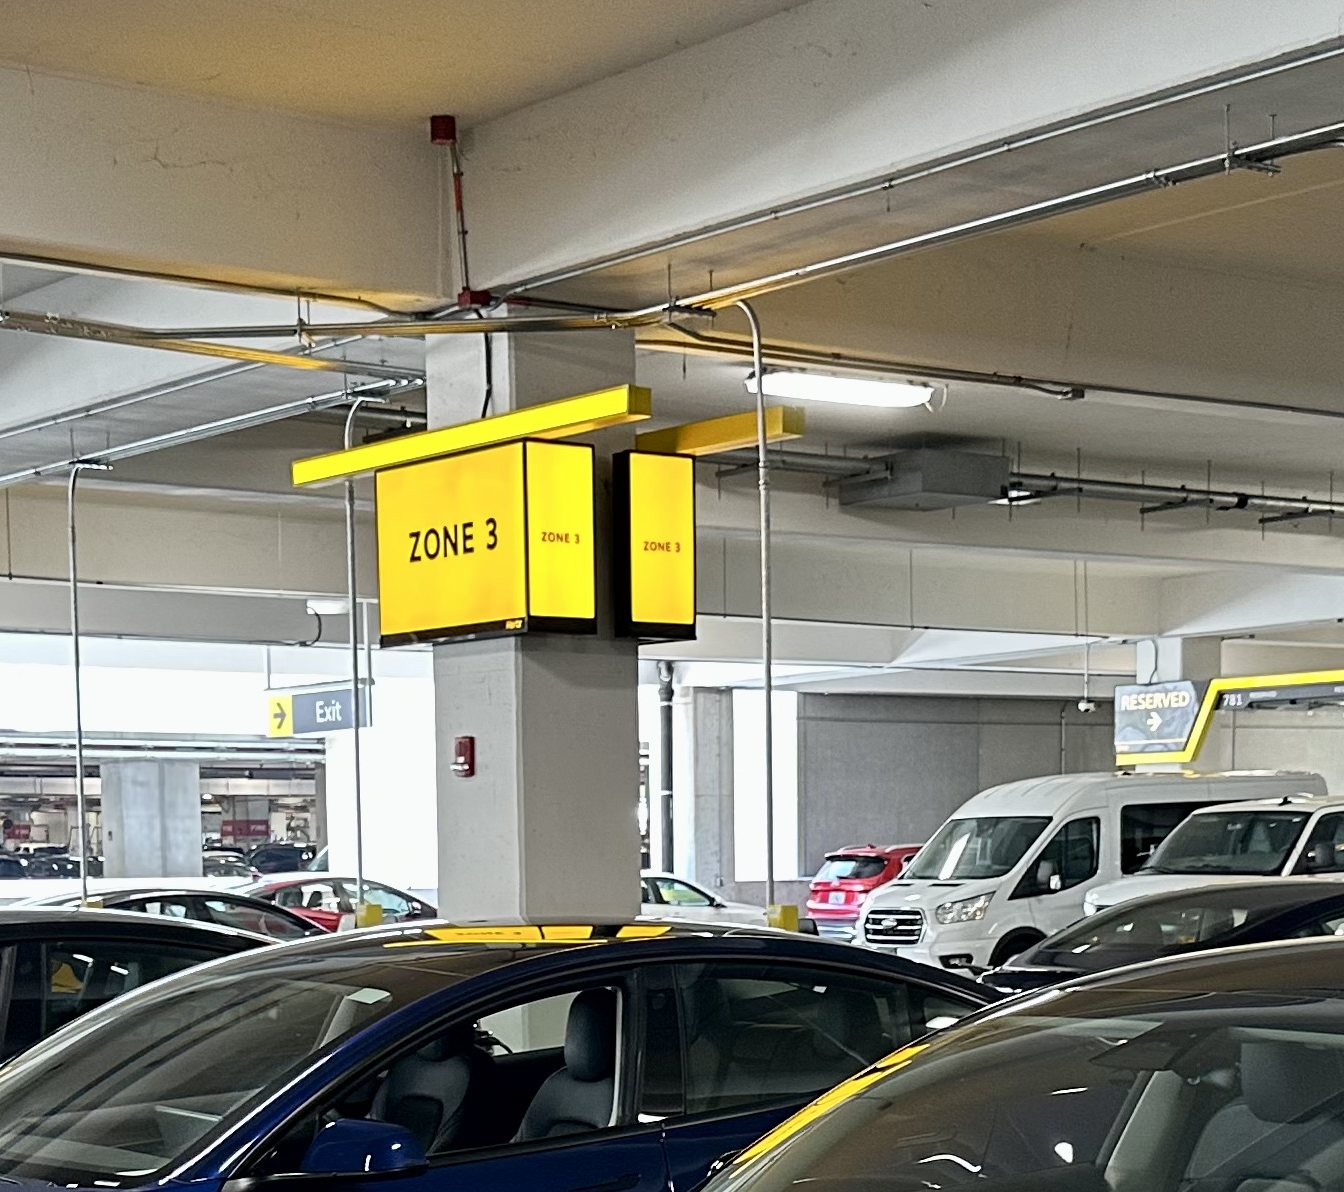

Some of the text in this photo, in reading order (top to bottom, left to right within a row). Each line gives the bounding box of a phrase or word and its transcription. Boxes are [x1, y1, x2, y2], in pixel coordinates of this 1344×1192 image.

[409, 517, 499, 563] ZONE 3
[541, 531, 581, 545] ZONE 3
[643, 541, 681, 553] ZONE 3
[315, 699, 343, 723] Exit
[1120, 690, 1191, 711] RESERVED
